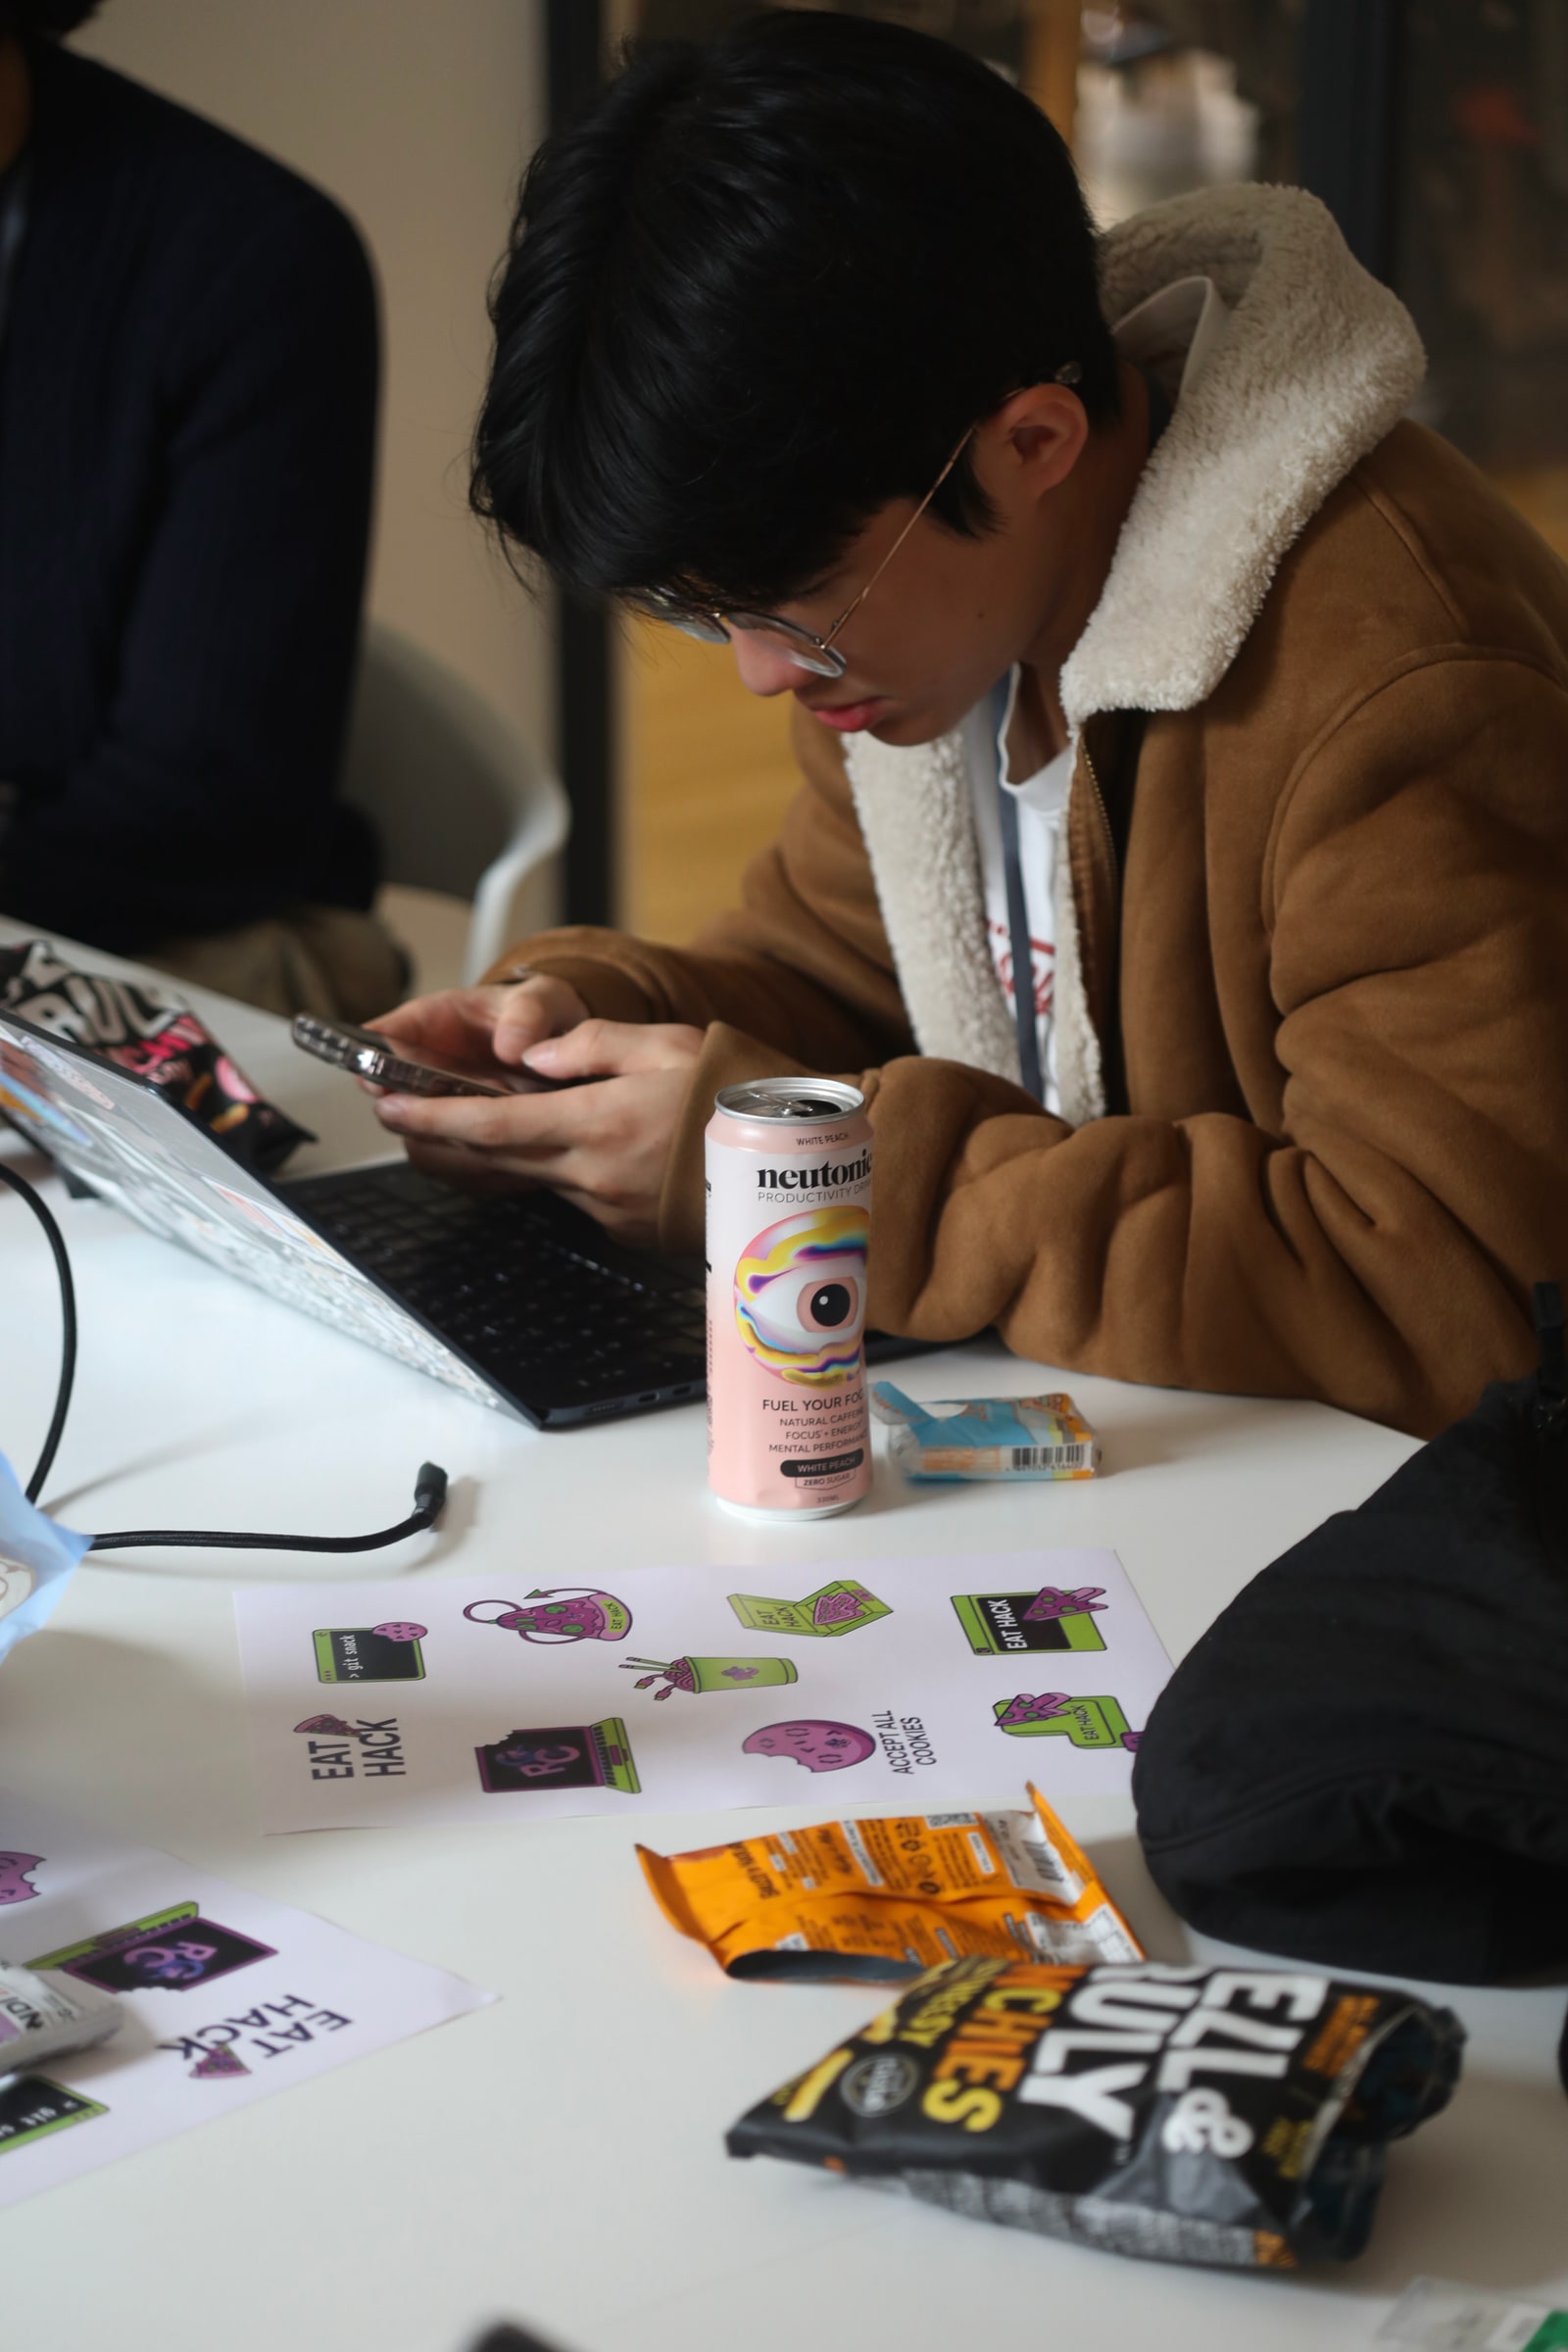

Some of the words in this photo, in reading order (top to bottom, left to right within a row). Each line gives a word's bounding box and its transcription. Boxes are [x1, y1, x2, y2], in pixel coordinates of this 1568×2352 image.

[796, 1137, 824, 1146] WHITE
[825, 1131, 849, 1144] PEACH
[756, 1148, 872, 1190] neutonic
[758, 1186, 852, 1203] PRODUCTIVITY
[762, 1398, 799, 1412] FUEL
[803, 1396, 842, 1411] YOUR
[779, 1417, 828, 1427] NATURAL
[785, 1430, 820, 1441] FOCUS
[831, 1420, 862, 1438] ENERGY
[768, 1444, 809, 1453] MENTAL
[797, 1462, 827, 1473] WHITE
[828, 1456, 856, 1470] PEACH
[804, 1478, 825, 1487] ZERO
[826, 1472, 851, 1484] SUGAR
[756, 1609, 780, 1625] EAT
[773, 1606, 803, 1627] HACK
[987, 1598, 1018, 1628] HACK
[338, 1634, 359, 1655] snack
[1001, 1630, 1028, 1649] EAT
[342, 1657, 365, 1671] git
[871, 1709, 899, 1730] ALL
[1070, 1704, 1094, 1726] HACK
[900, 1716, 938, 1766] COOKIES
[1079, 1726, 1100, 1740] EAT
[356, 1718, 407, 1778] HACK
[878, 1732, 915, 1776] ACCEPT
[307, 1740, 355, 1781] EAT
[154, 1993, 316, 2061] HACK
[251, 2009, 354, 2059] EAT
[1156, 1971, 1329, 2093] ELL
[1161, 2086, 1255, 2159] &
